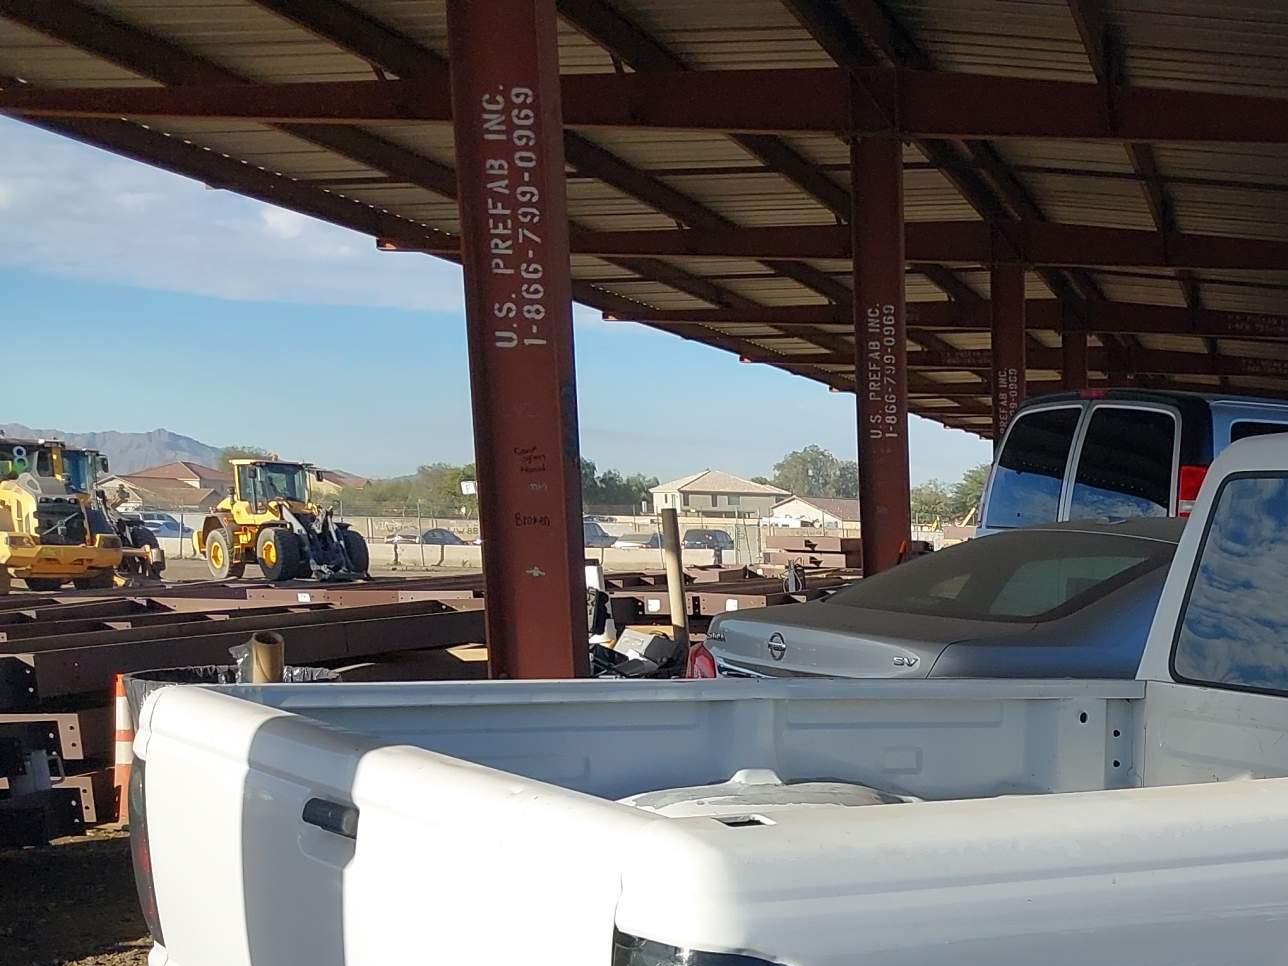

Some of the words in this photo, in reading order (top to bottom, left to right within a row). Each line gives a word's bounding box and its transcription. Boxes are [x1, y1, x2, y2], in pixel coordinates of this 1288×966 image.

[481, 84, 507, 140] INC.
[486, 159, 515, 274] PREFAB
[511, 87, 547, 346] 1-866-799-0969
[494, 293, 518, 348] U.S.
[867, 303, 880, 333] INC.
[868, 340, 881, 401] PREFAB
[882, 304, 898, 438] 1-866-799-0969
[870, 409, 882, 439] U.S.
[893, 656, 919, 668] SV
